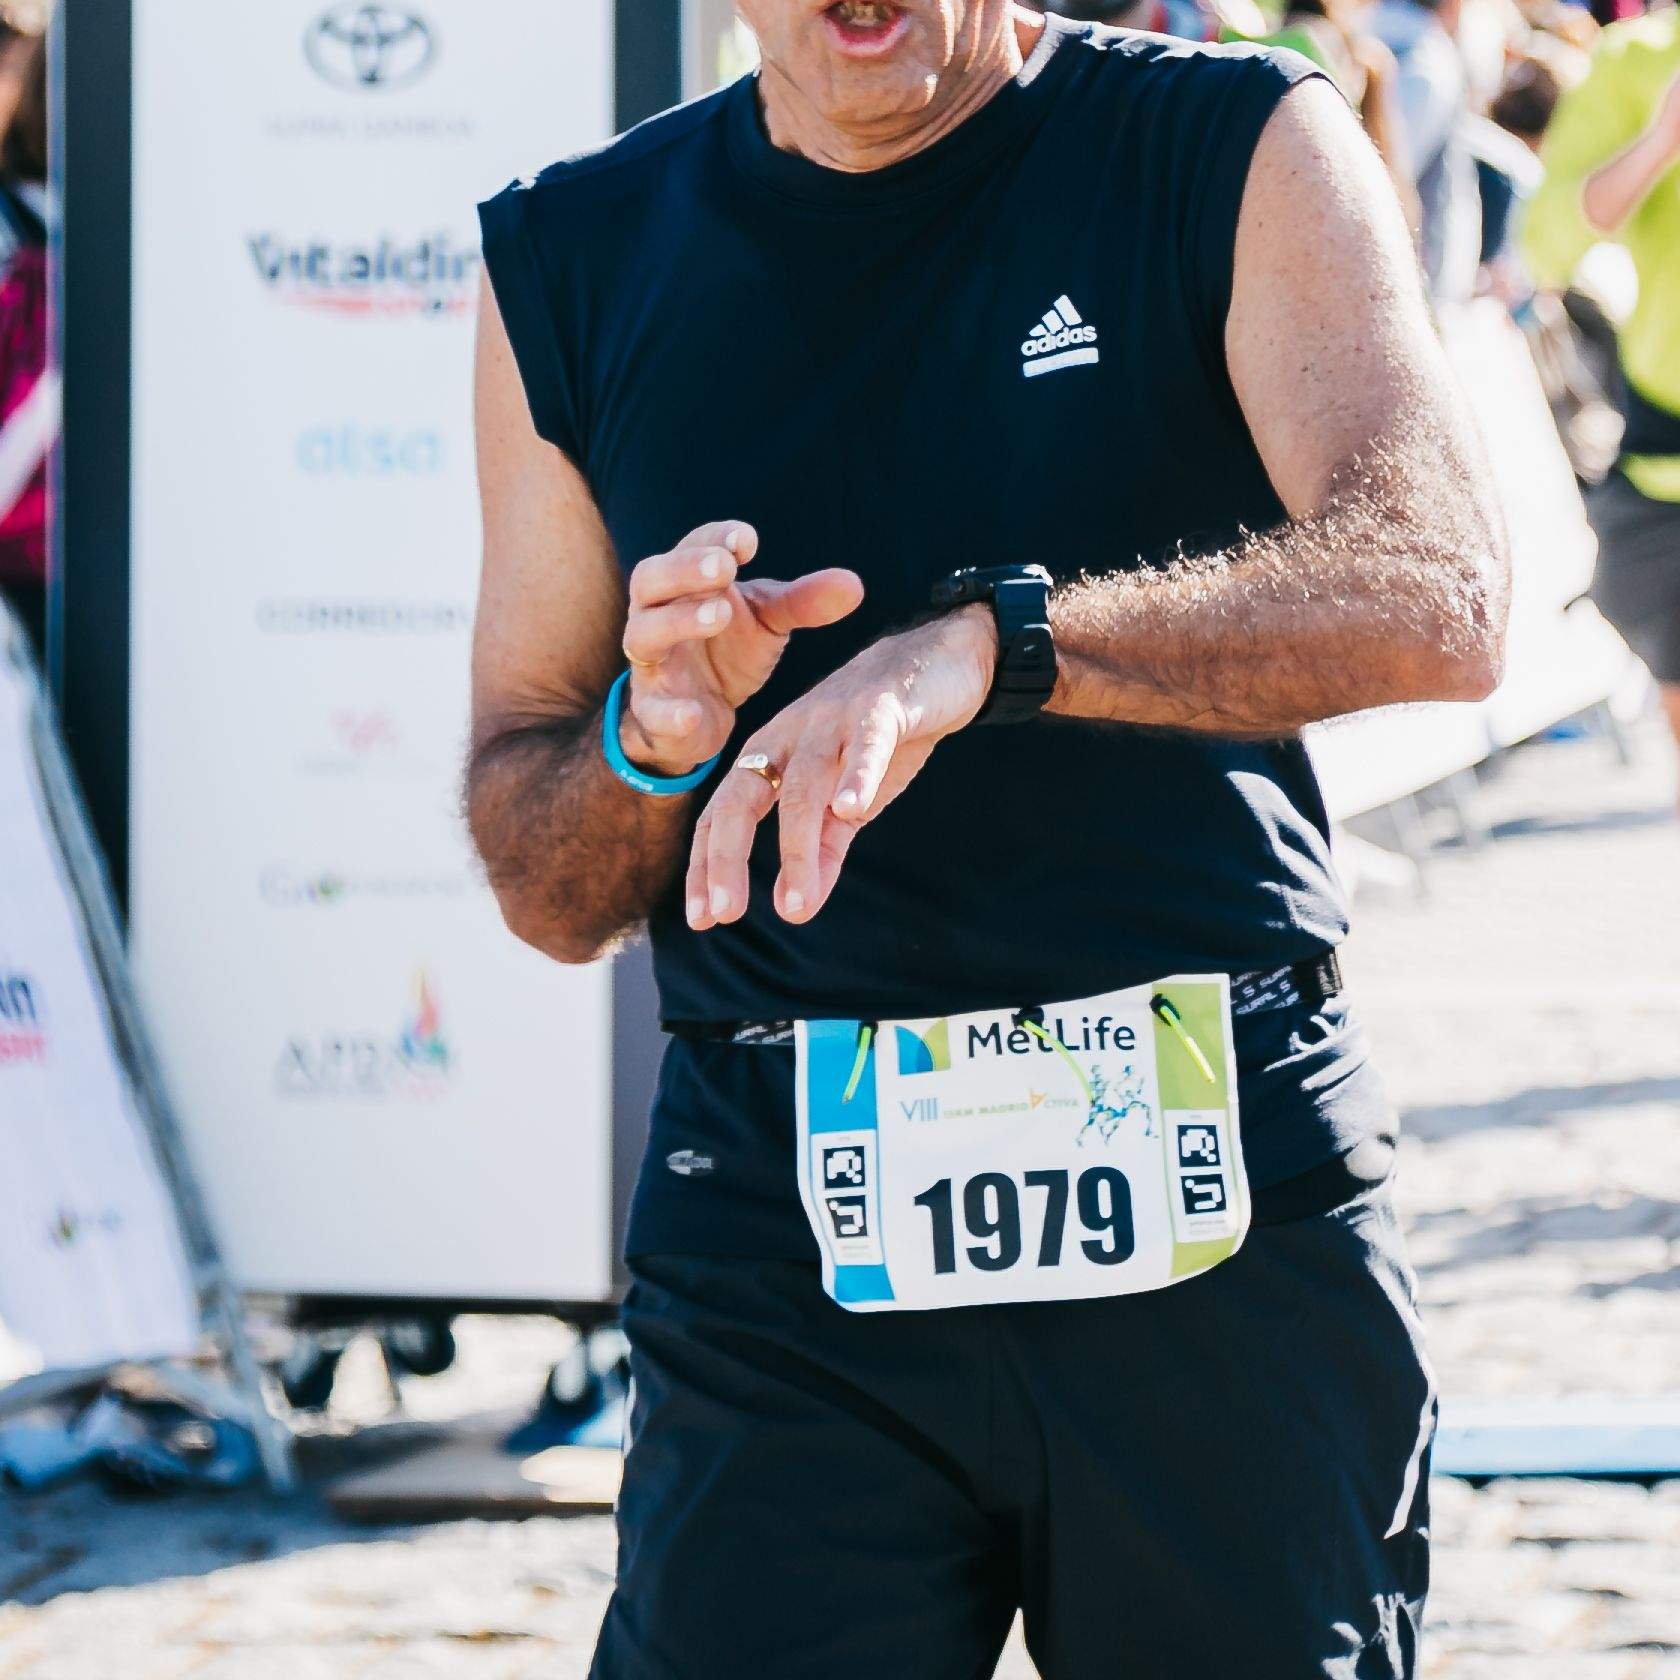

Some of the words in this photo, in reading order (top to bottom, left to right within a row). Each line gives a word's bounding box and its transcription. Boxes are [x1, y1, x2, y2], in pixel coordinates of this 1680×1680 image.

[1021, 325, 1098, 357] adidas
[967, 1016, 1136, 1059] MetLife
[899, 1097, 939, 1123] VIII
[914, 1166, 1137, 1276] 1979
